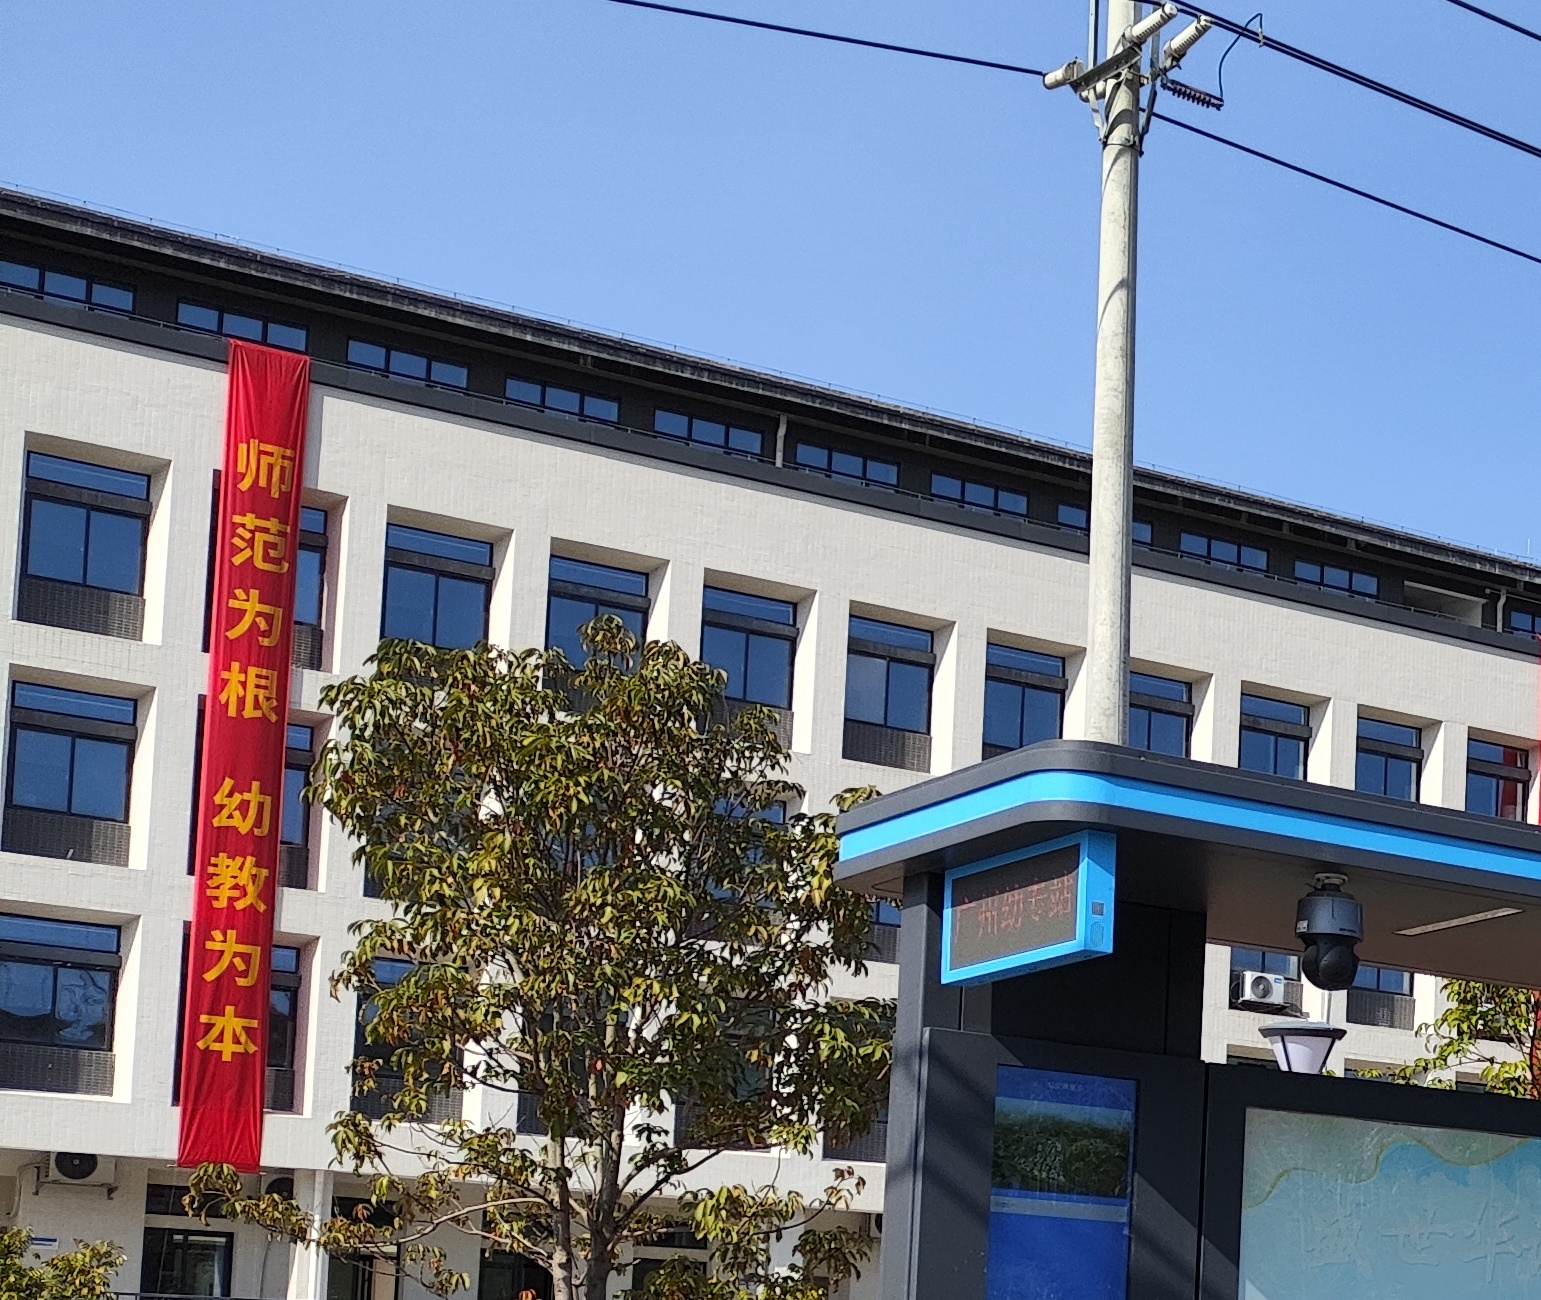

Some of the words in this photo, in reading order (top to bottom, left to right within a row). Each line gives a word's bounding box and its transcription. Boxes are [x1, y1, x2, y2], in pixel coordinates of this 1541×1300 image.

[219, 438, 296, 725] 师范为根
[197, 776, 272, 1064] 幼教为本
[953, 870, 1074, 944] 广州幼专站
